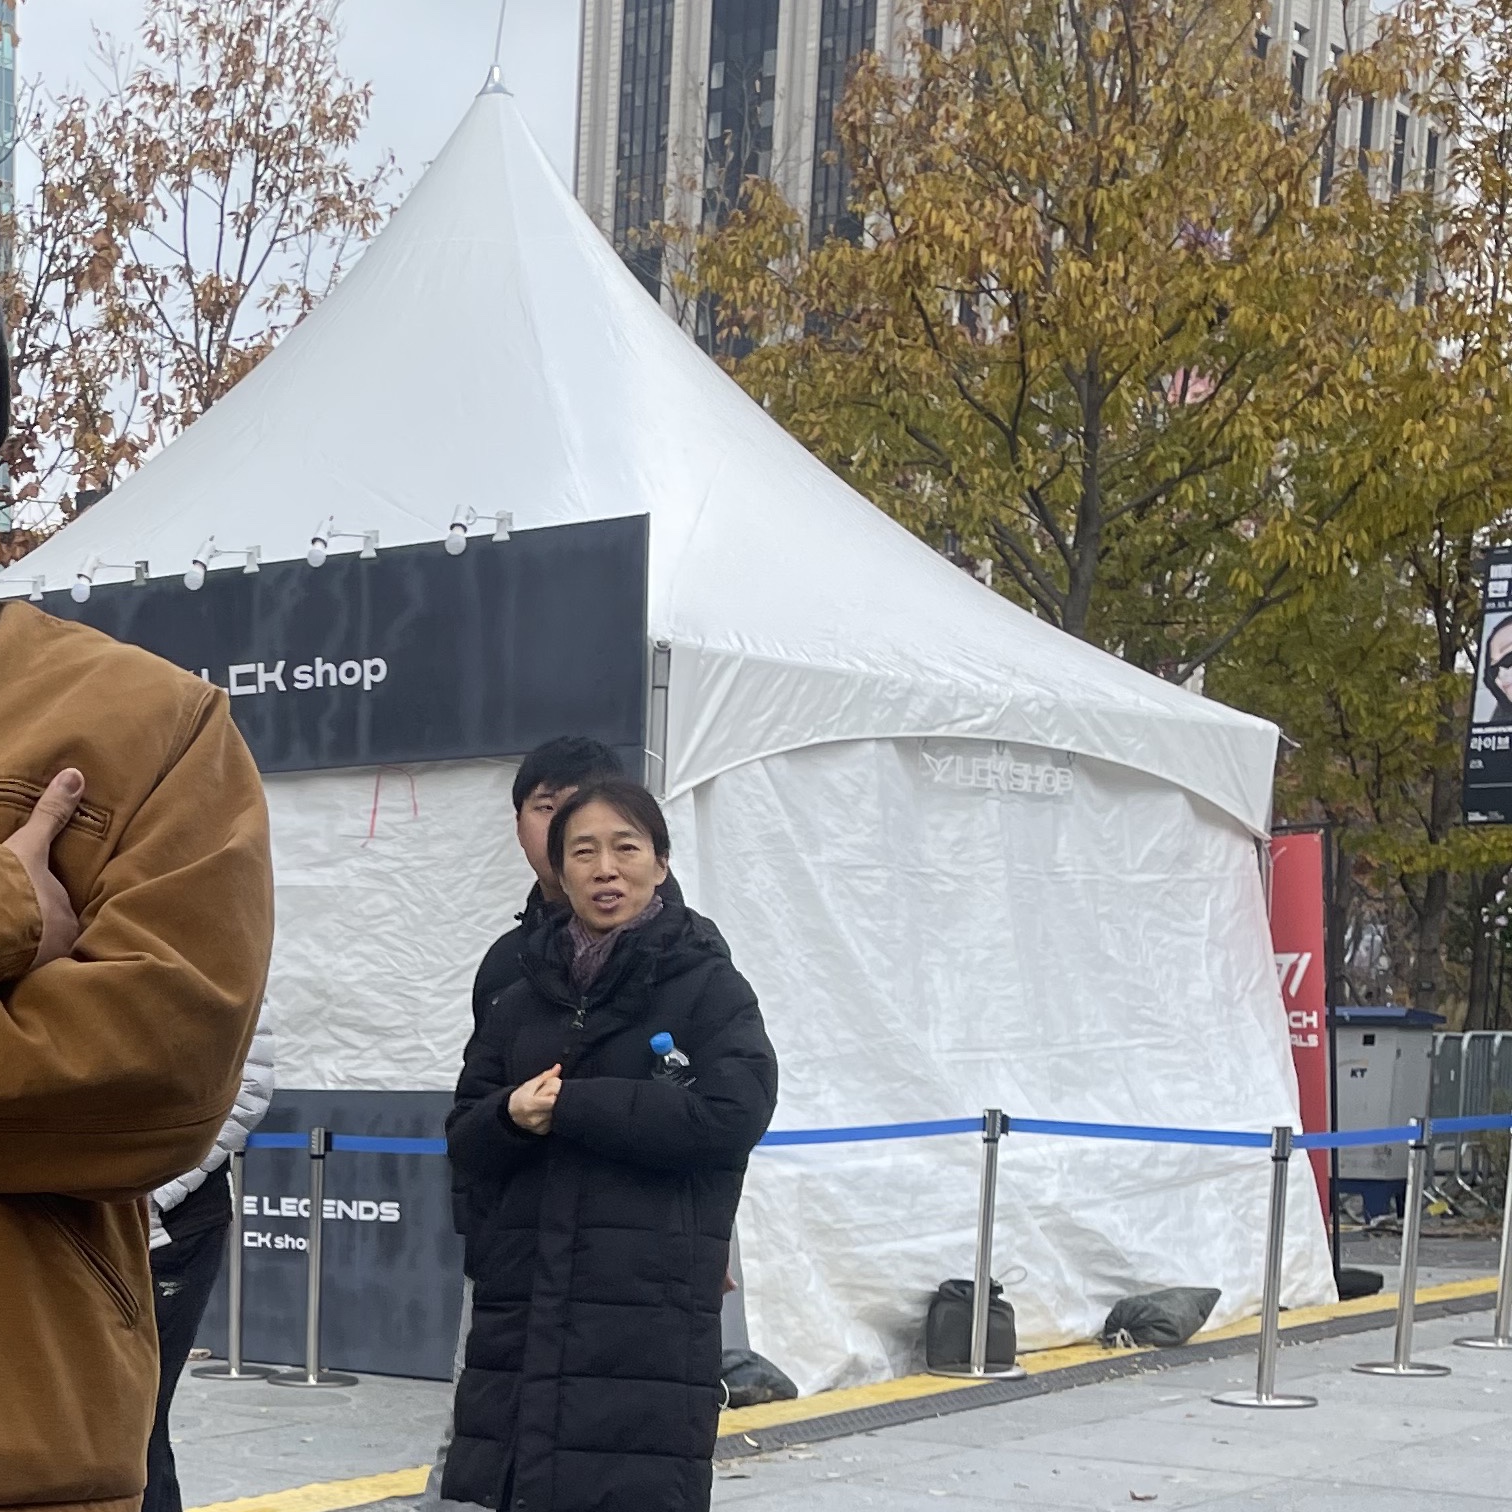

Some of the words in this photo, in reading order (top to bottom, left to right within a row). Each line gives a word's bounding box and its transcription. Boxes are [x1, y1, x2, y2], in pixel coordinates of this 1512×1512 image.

[293, 656, 388, 691] shop
[1009, 762, 1074, 796] SHOP
[1350, 1067, 1368, 1079] KT
[273, 1233, 311, 1251] sho
